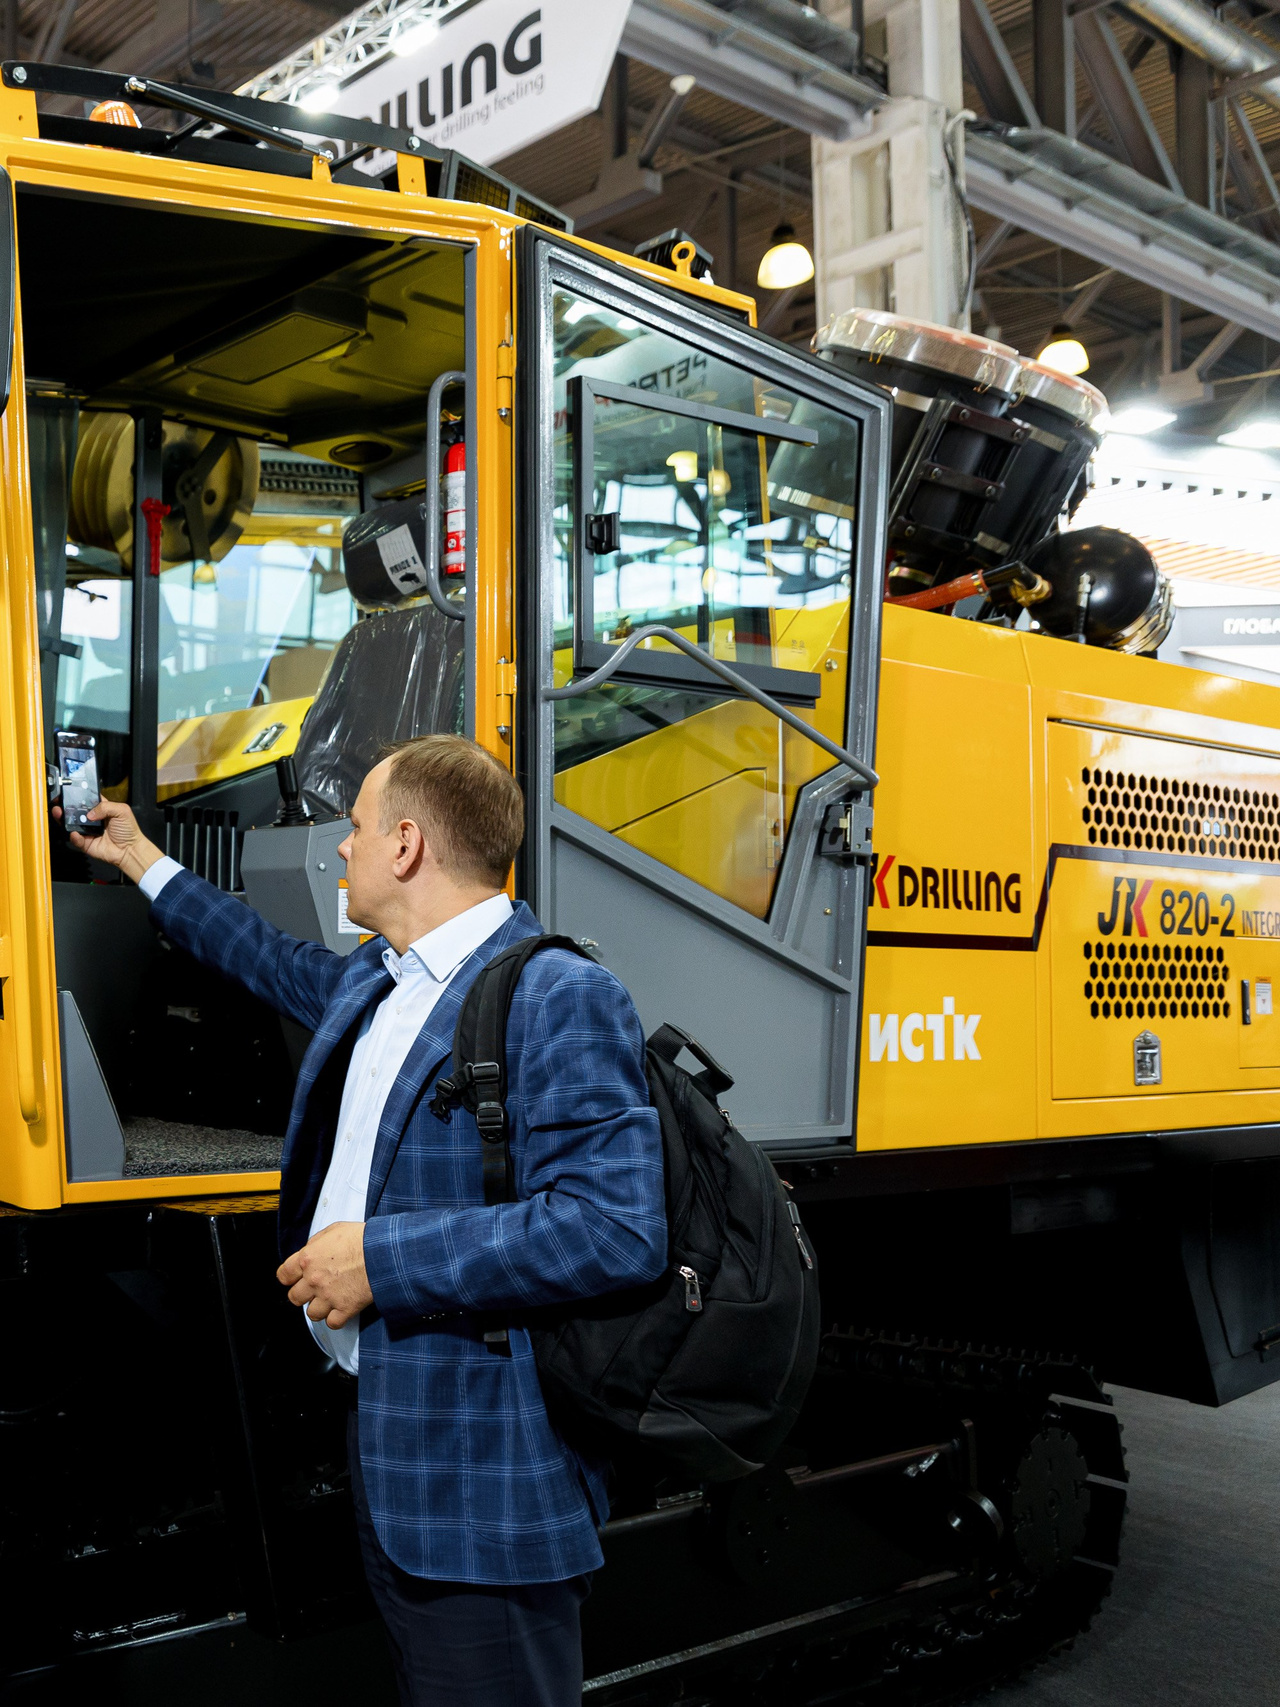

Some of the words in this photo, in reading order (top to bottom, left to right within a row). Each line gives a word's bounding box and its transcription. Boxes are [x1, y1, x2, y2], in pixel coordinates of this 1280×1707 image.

[441, 104, 489, 142] drilling
[494, 73, 544, 112] feeling
[867, 853, 896, 909] K
[898, 864, 1021, 914] DRILLING
[1097, 876, 1154, 938] JK
[1160, 889, 1235, 937] 820-2
